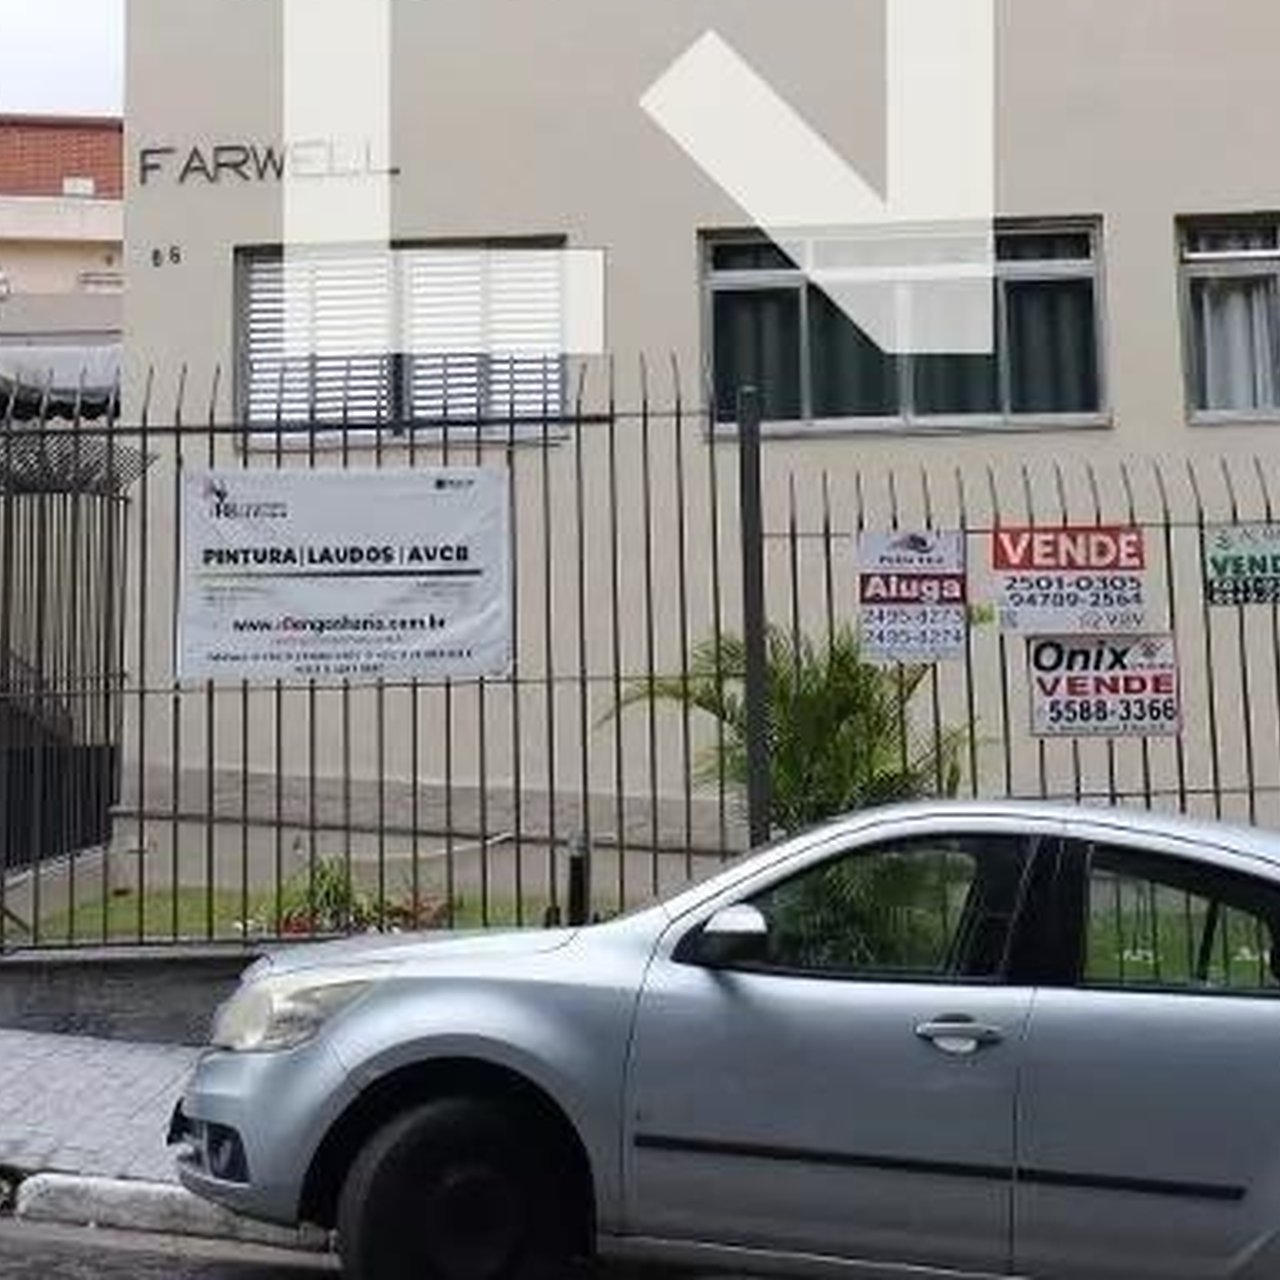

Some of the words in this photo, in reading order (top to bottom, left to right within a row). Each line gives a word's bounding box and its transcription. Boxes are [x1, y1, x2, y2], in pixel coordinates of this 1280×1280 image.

[139, 139, 400, 185] FARWELL
[203, 548, 297, 565] PINTURA
[308, 546, 393, 564] LAUDOS
[1000, 532, 1141, 567] VENDE
[865, 576, 962, 603] Aluga
[1005, 575, 1142, 591] 2501-0305
[1033, 640, 1130, 672] Onix
[1036, 674, 1174, 697] VENDE
[1049, 698, 1176, 722] 5588-3366
